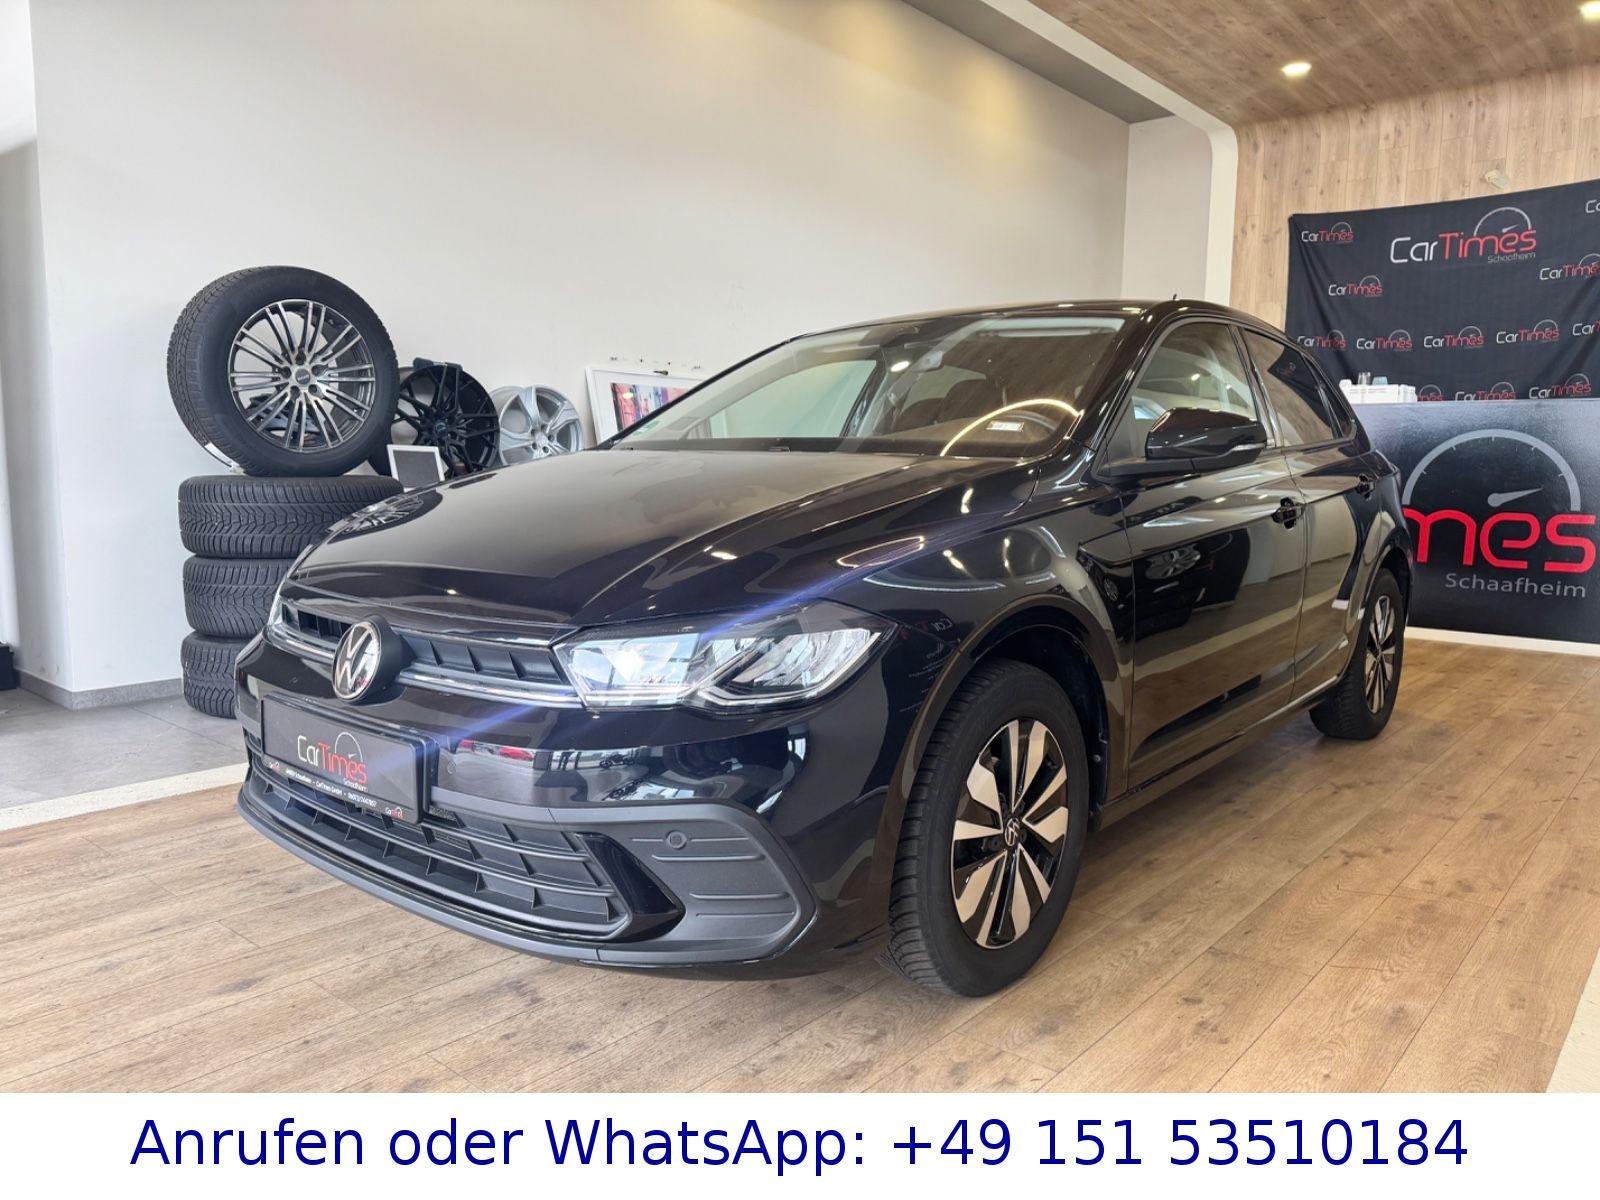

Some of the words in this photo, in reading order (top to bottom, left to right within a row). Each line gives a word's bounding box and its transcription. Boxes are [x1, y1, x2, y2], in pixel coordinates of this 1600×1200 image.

[1301, 229, 1354, 243] CarTimes
[1390, 229, 1537, 264] CarTimes
[1328, 283, 1384, 297] CarTimes
[1356, 337, 1413, 351] CarTimes
[1424, 333, 1485, 349] CarTimes
[1496, 327, 1561, 345] CarTimes
[1529, 383, 1592, 399] CarTimes
[1444, 572, 1586, 598] Schaafheim
[297, 735, 368, 785] CarTimes
